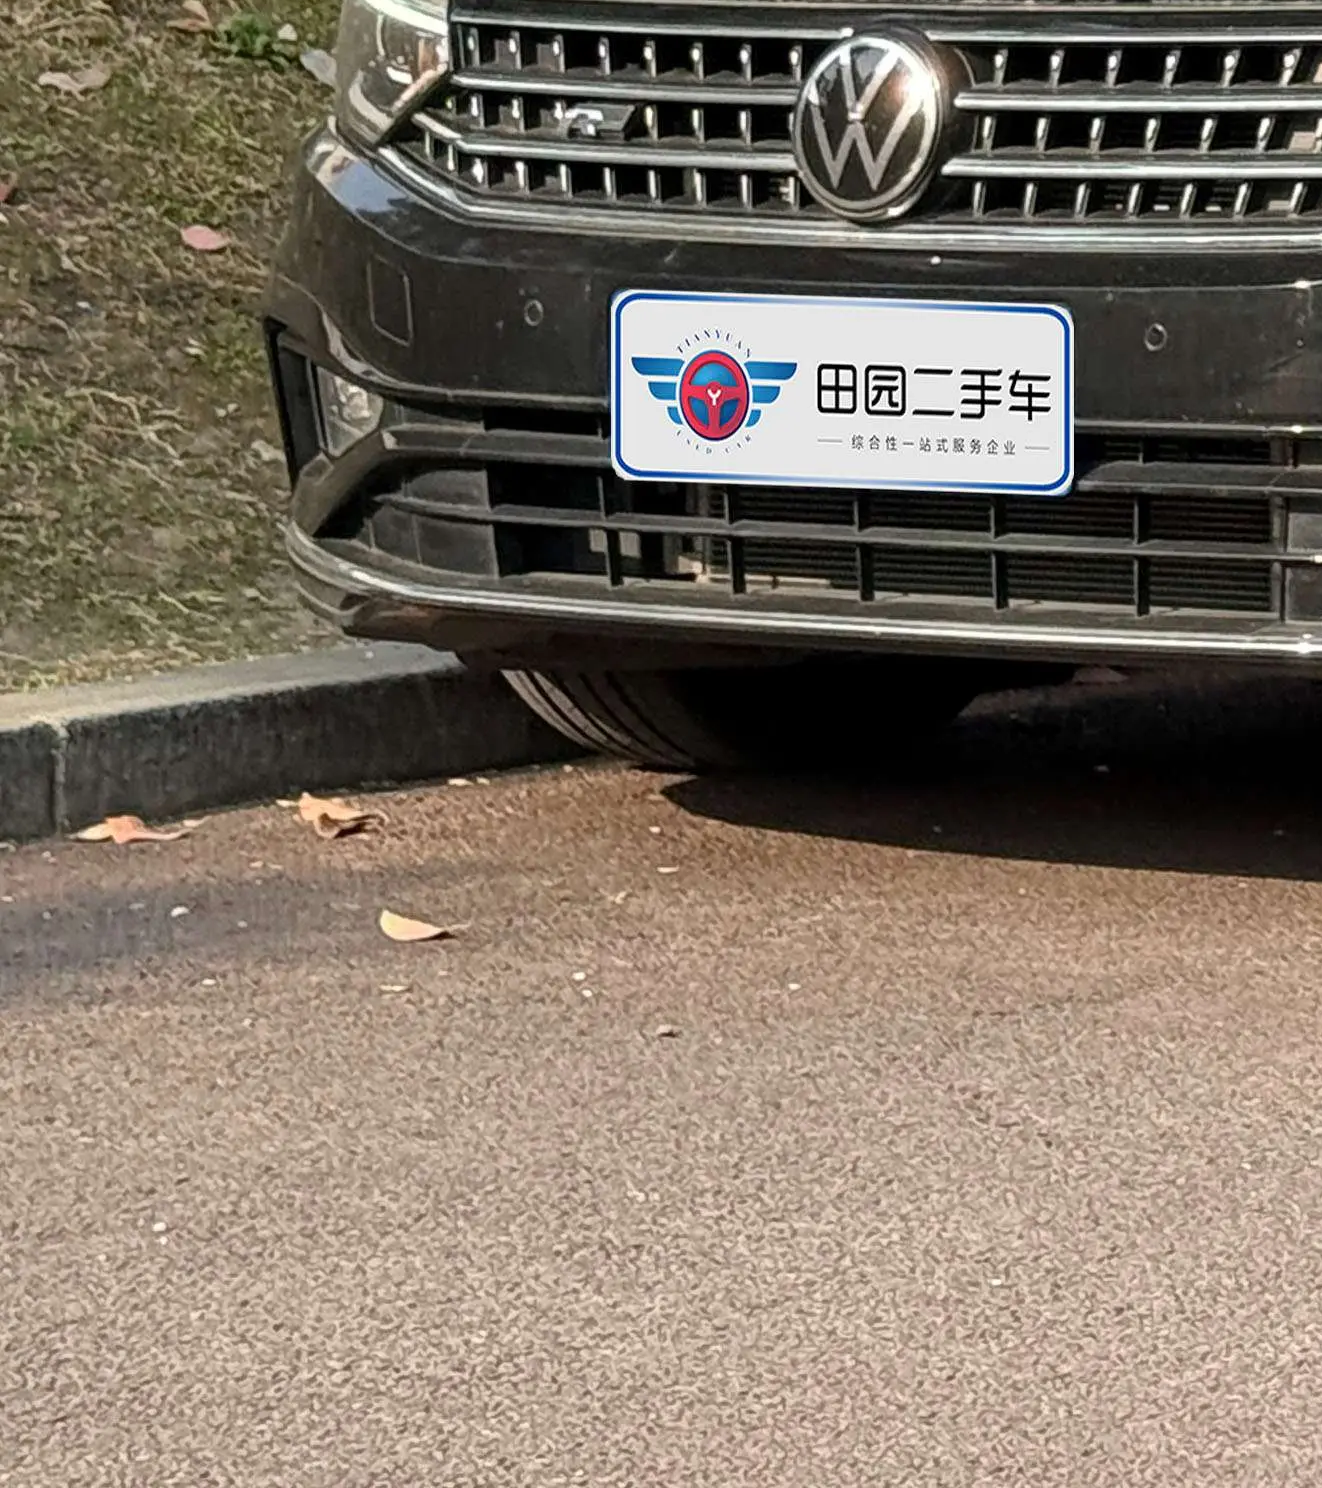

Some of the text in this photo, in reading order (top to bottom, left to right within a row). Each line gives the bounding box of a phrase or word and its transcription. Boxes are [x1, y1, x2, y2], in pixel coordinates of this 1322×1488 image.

[817, 363, 1051, 421] 田园二手车
[851, 434, 1016, 455] 综合性一站式服务企业
